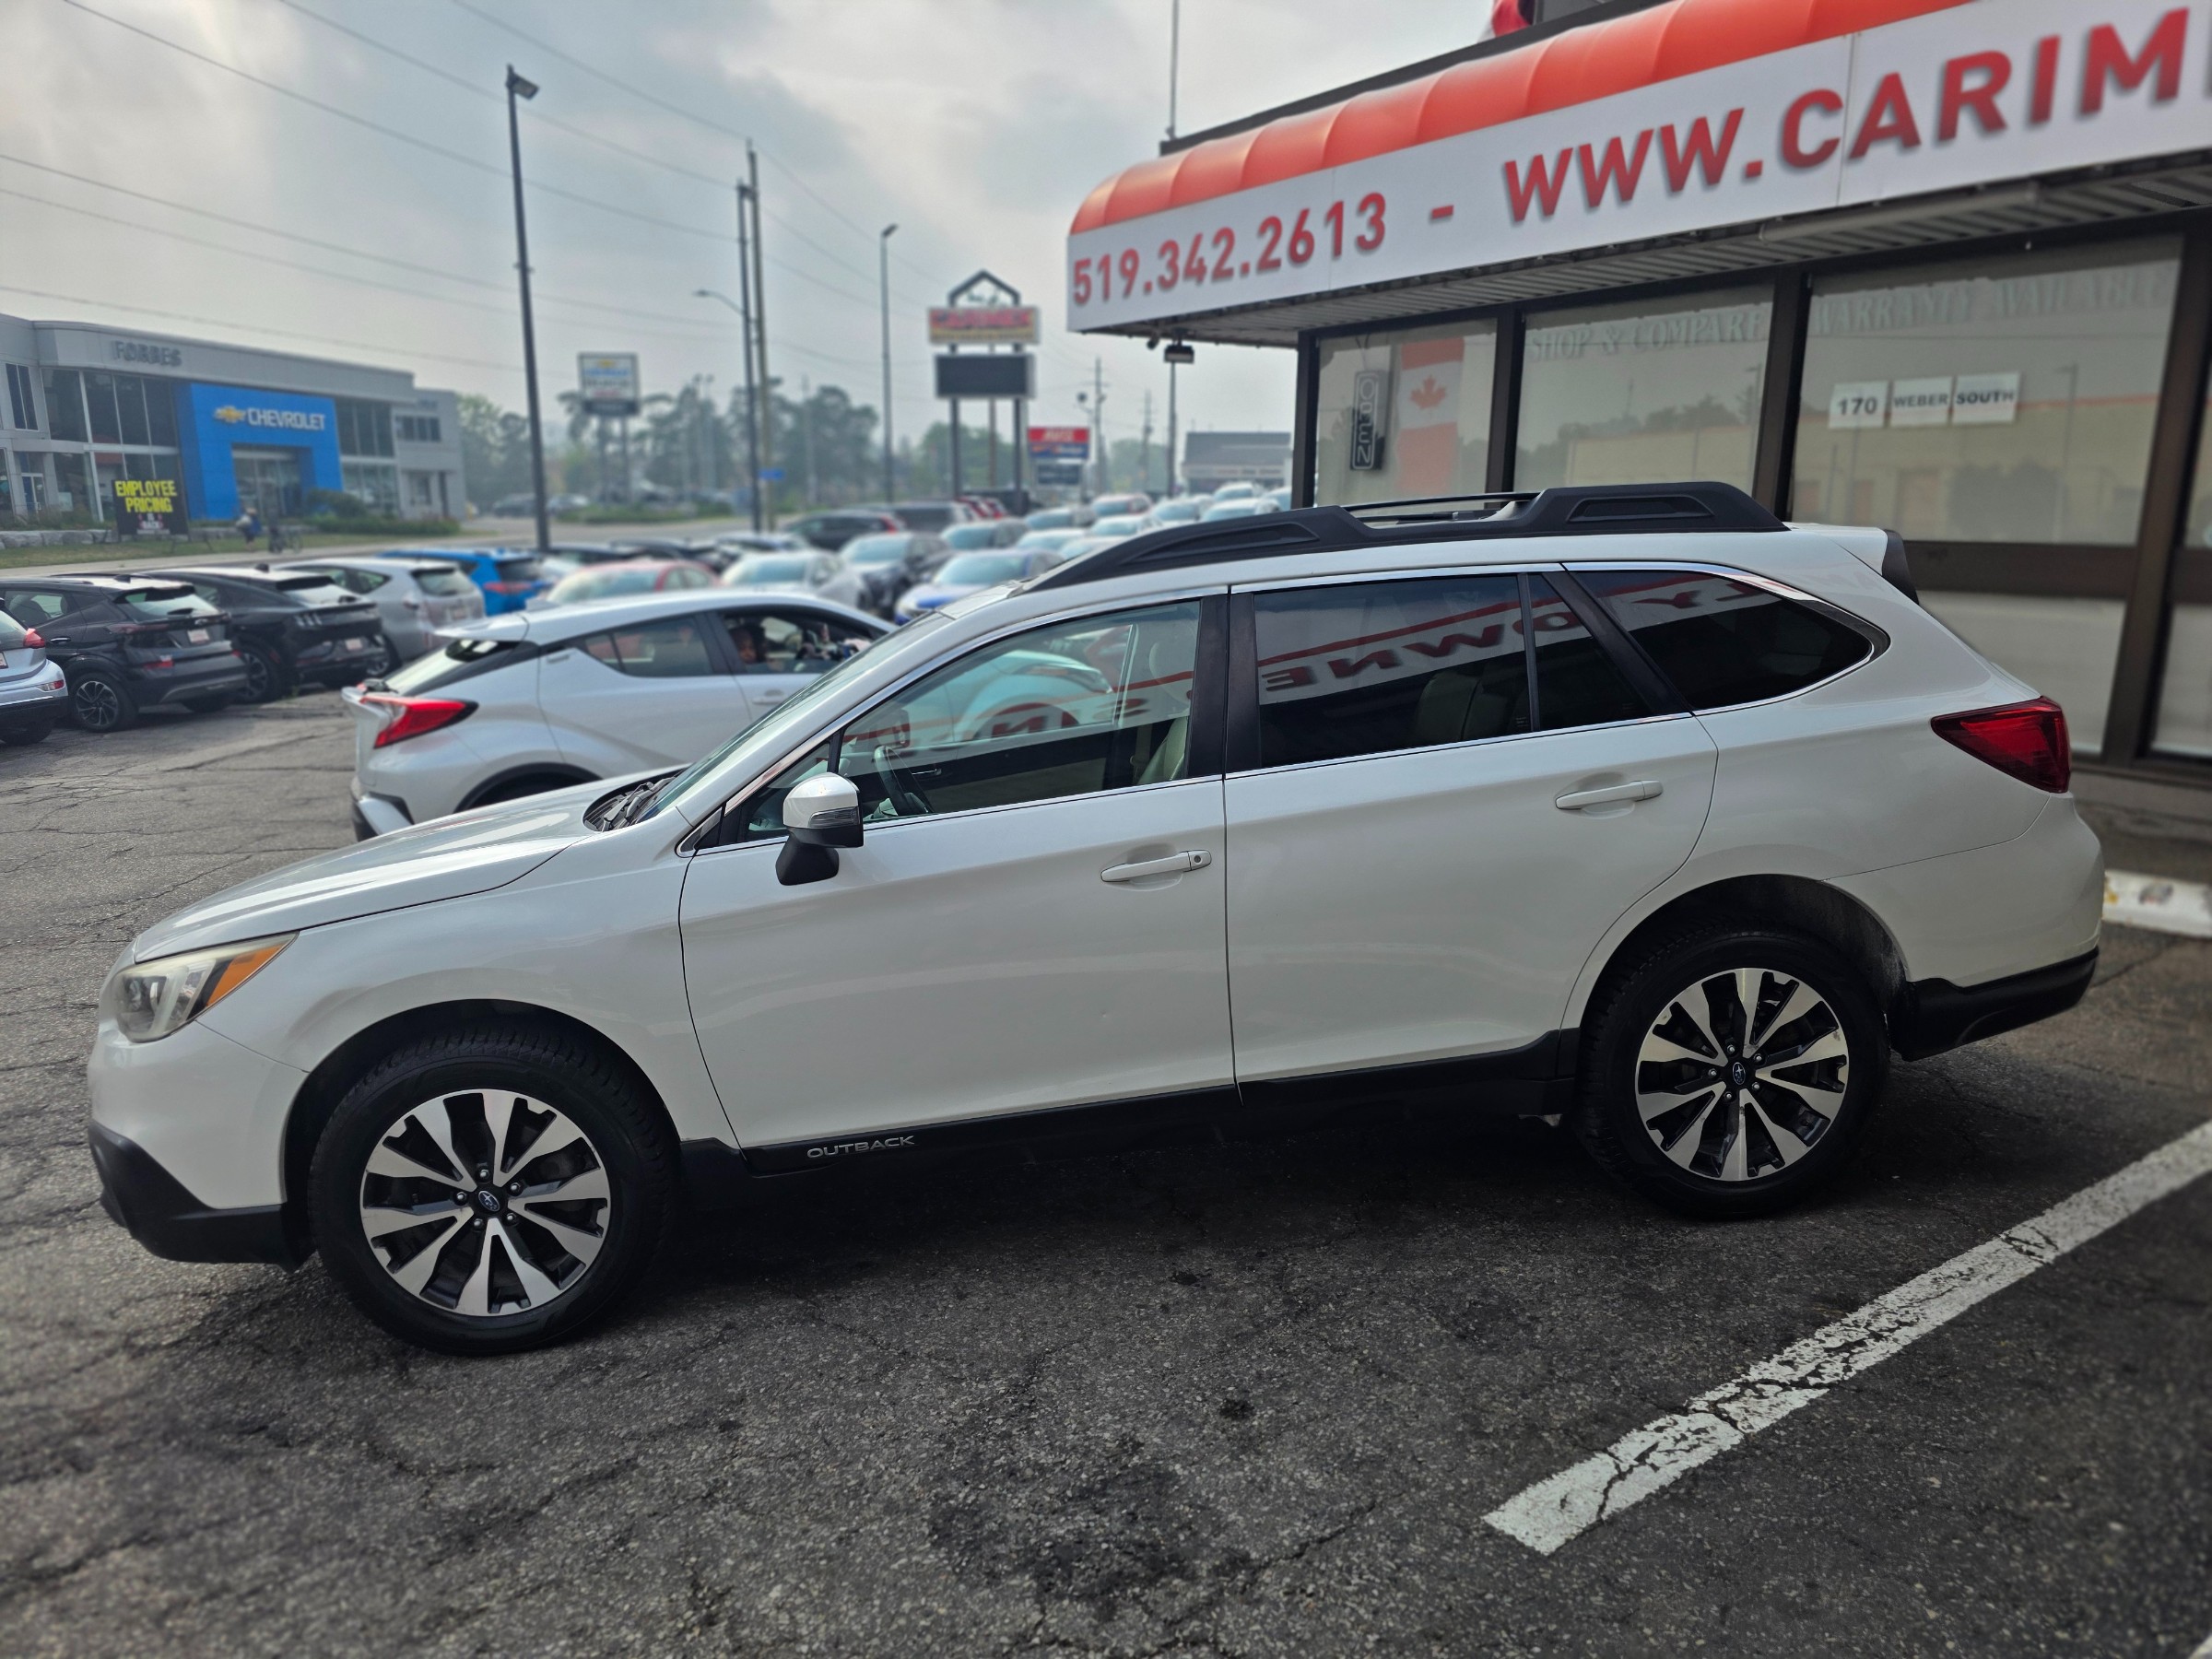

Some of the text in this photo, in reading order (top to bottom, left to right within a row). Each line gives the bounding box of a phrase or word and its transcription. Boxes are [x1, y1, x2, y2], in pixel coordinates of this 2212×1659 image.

[1073, 192, 1387, 306] 519.342.2613
[1502, 6, 2211, 223] WWW.CARIM
[112, 340, 182, 367] FORBES
[1525, 329, 1592, 362] SHOP
[1837, 389, 2014, 416] 170 WEBER SOUTH
[247, 407, 325, 430] CHEVROLET
[1358, 378, 1375, 463] OPEN
[114, 480, 178, 497] EMPLOYEE
[125, 497, 173, 512] PRICING
[806, 1135, 915, 1159] OUTBACK
